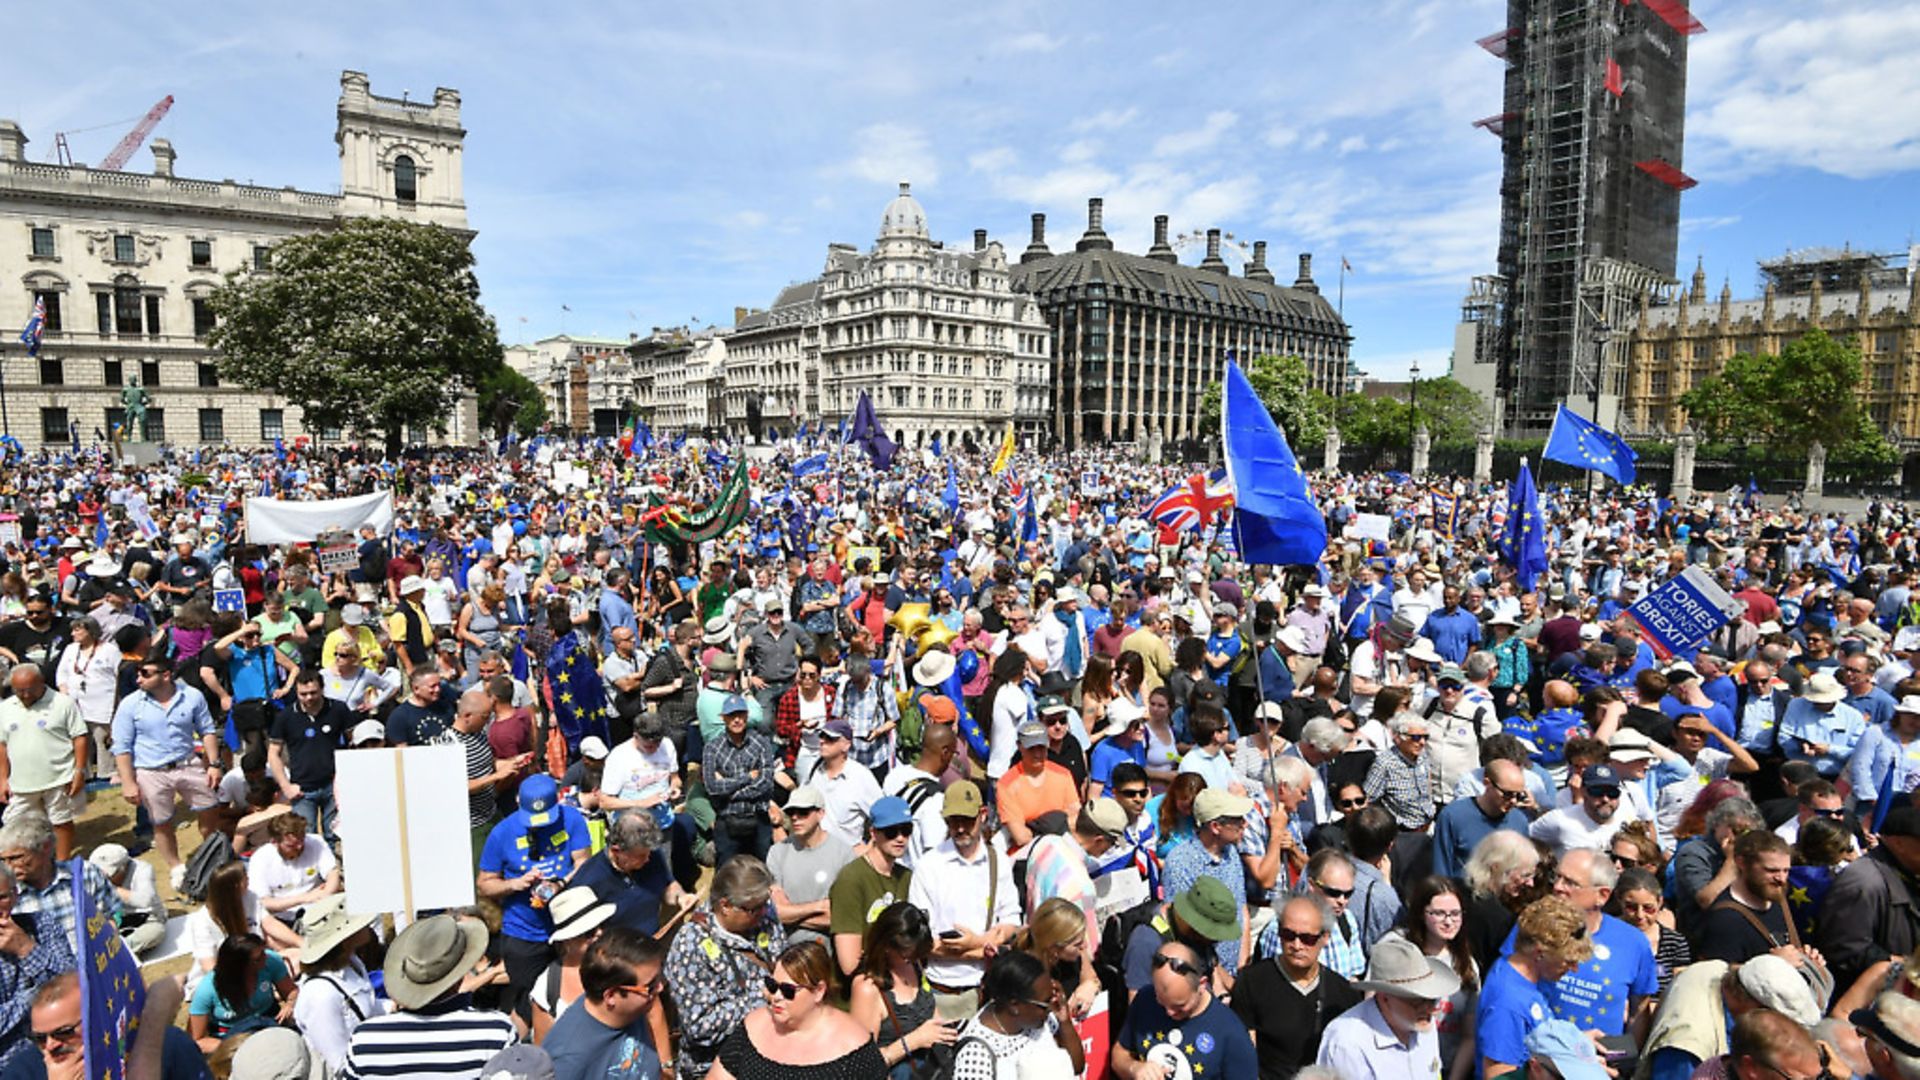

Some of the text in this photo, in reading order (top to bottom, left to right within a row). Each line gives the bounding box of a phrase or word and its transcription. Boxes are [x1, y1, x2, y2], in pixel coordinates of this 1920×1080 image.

[1636, 600, 1691, 646] BREXIT
[1650, 592, 1704, 637] AGAINST
[1665, 581, 1718, 630] TORIES
